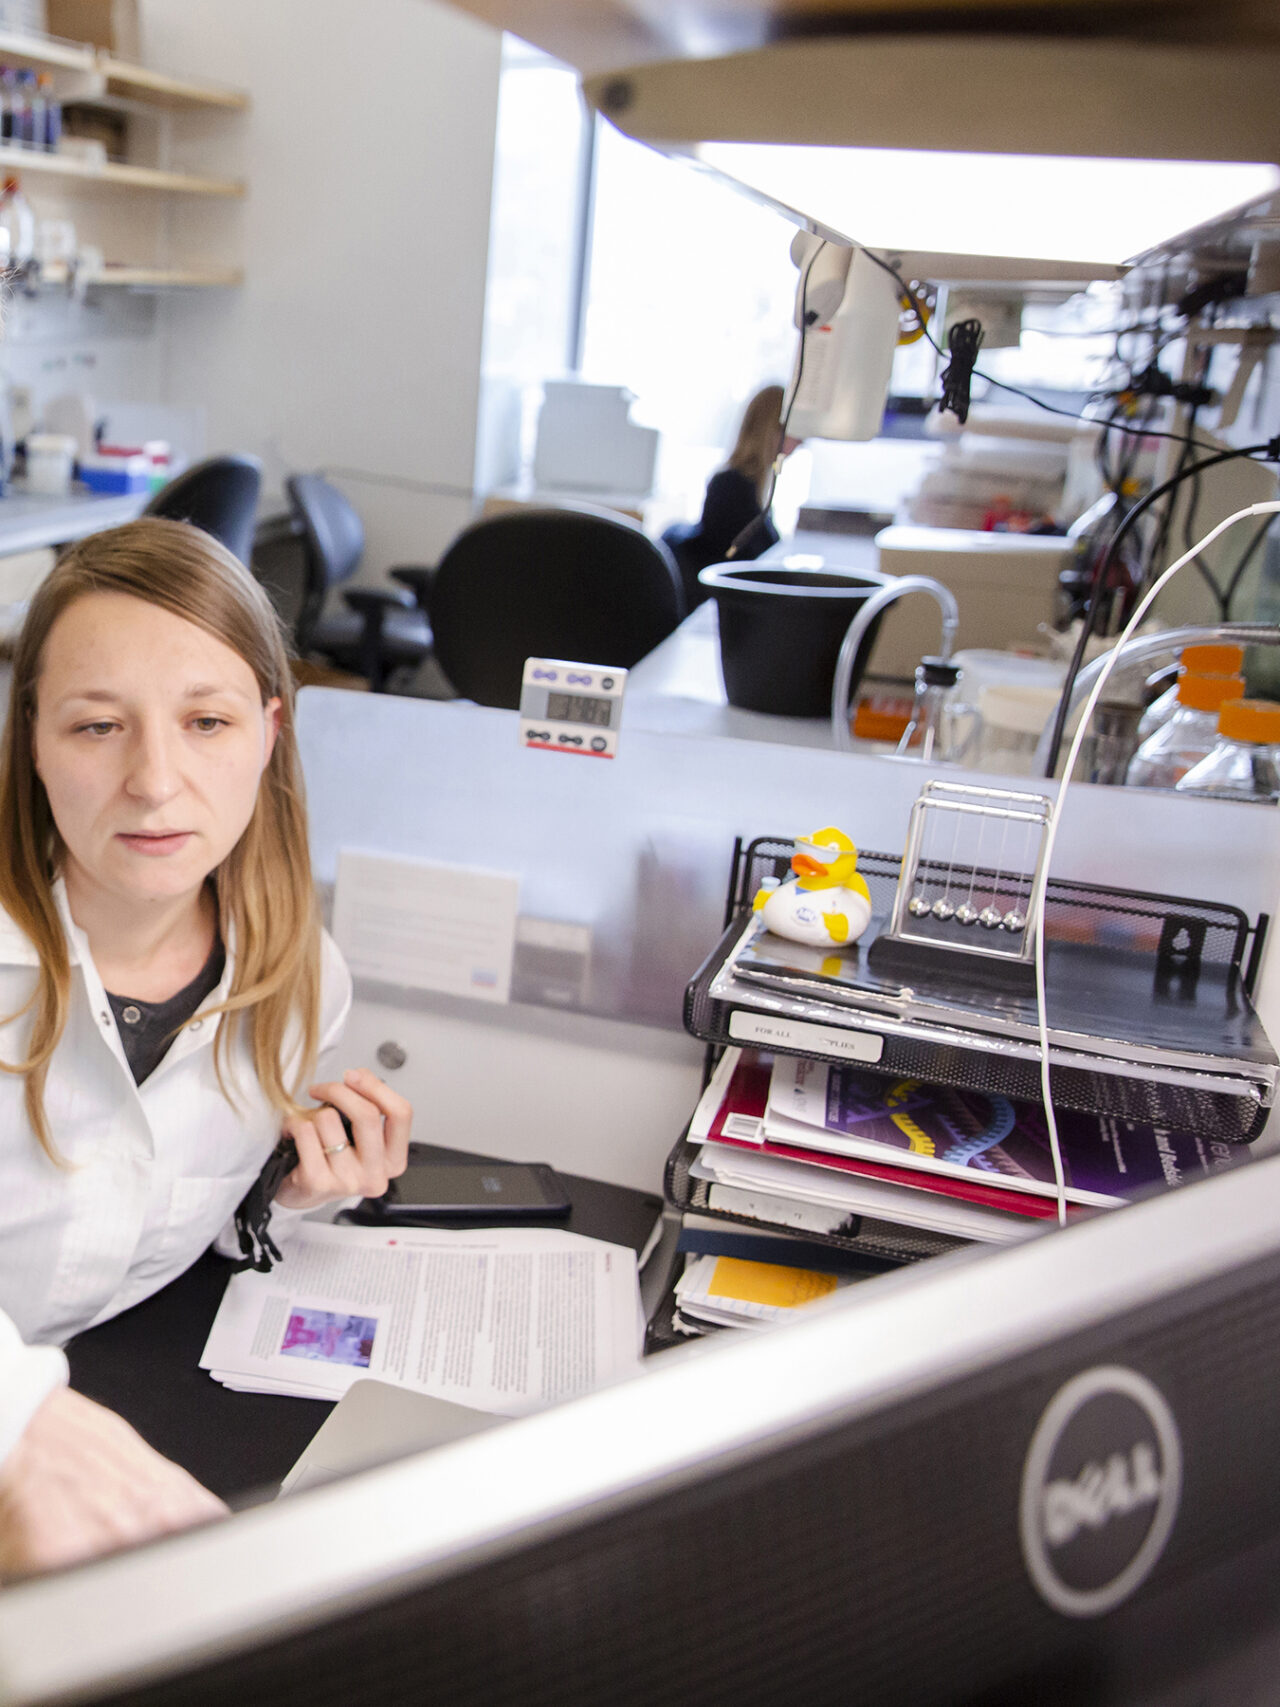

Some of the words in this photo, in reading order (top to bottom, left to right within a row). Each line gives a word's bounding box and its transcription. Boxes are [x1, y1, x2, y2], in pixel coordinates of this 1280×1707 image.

[754, 1026, 772, 1035] FOR
[775, 1029, 792, 1038] ALL
[1045, 1440, 1159, 1547] DELL
